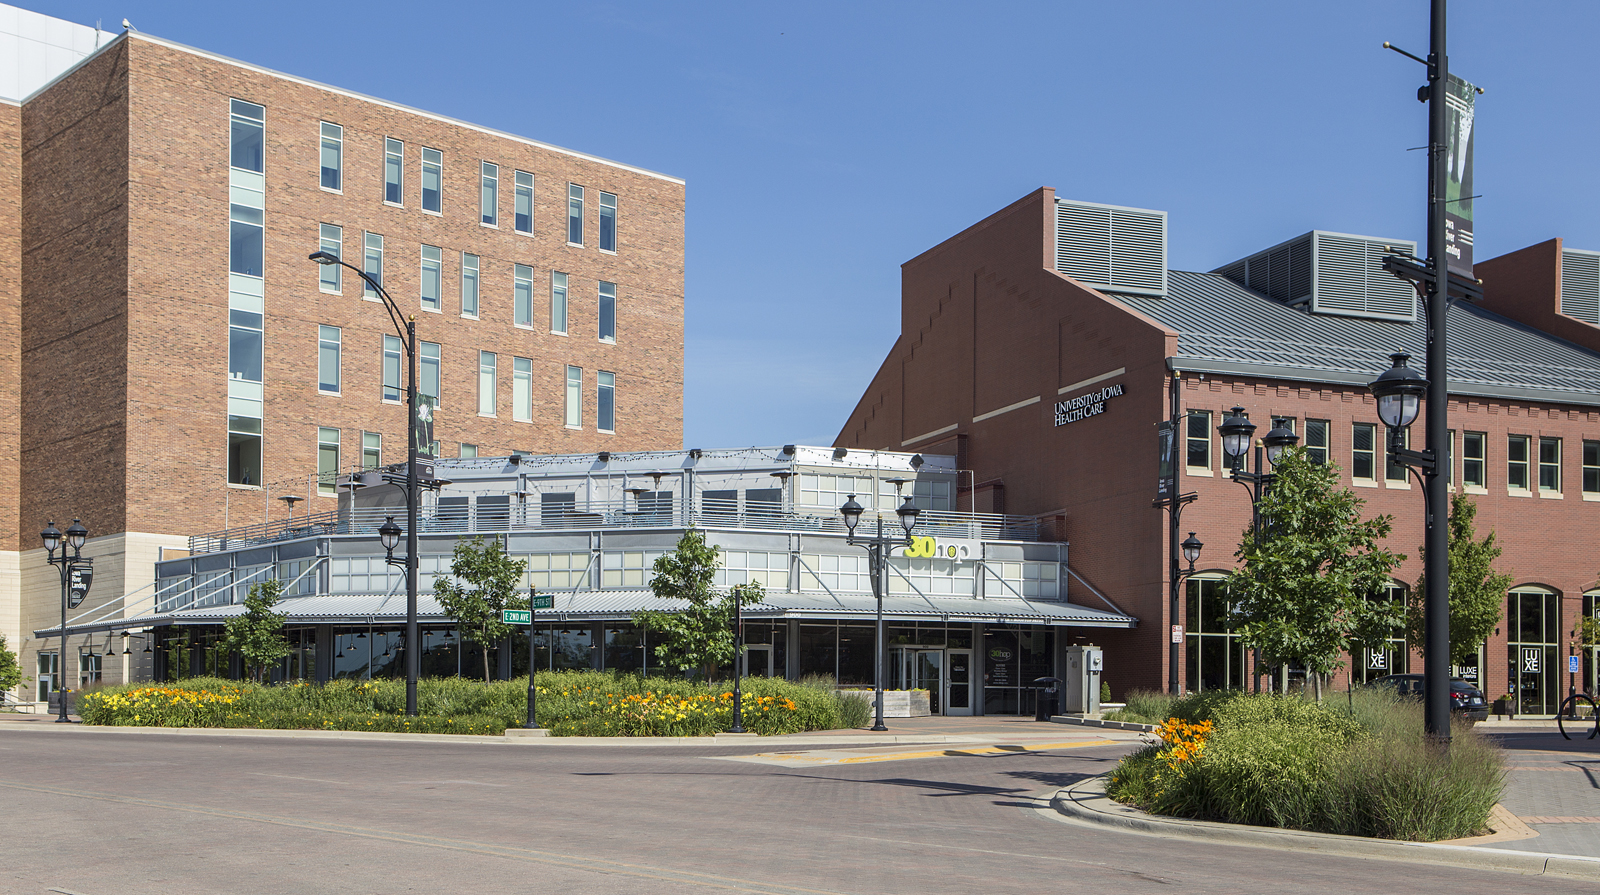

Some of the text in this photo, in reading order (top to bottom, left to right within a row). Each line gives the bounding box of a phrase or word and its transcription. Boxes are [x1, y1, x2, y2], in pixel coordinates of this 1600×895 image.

[1446, 244, 1461, 260] anding
[1054, 392, 1095, 415] UNIVERSITY
[1102, 384, 1123, 401] IOWA
[1054, 402, 1104, 427] HEALTH CARE
[904, 536, 971, 564] 30hop
[71, 582, 87, 591] Landing
[520, 613, 530, 622] AVE
[1460, 666, 1477, 674] LUXE
